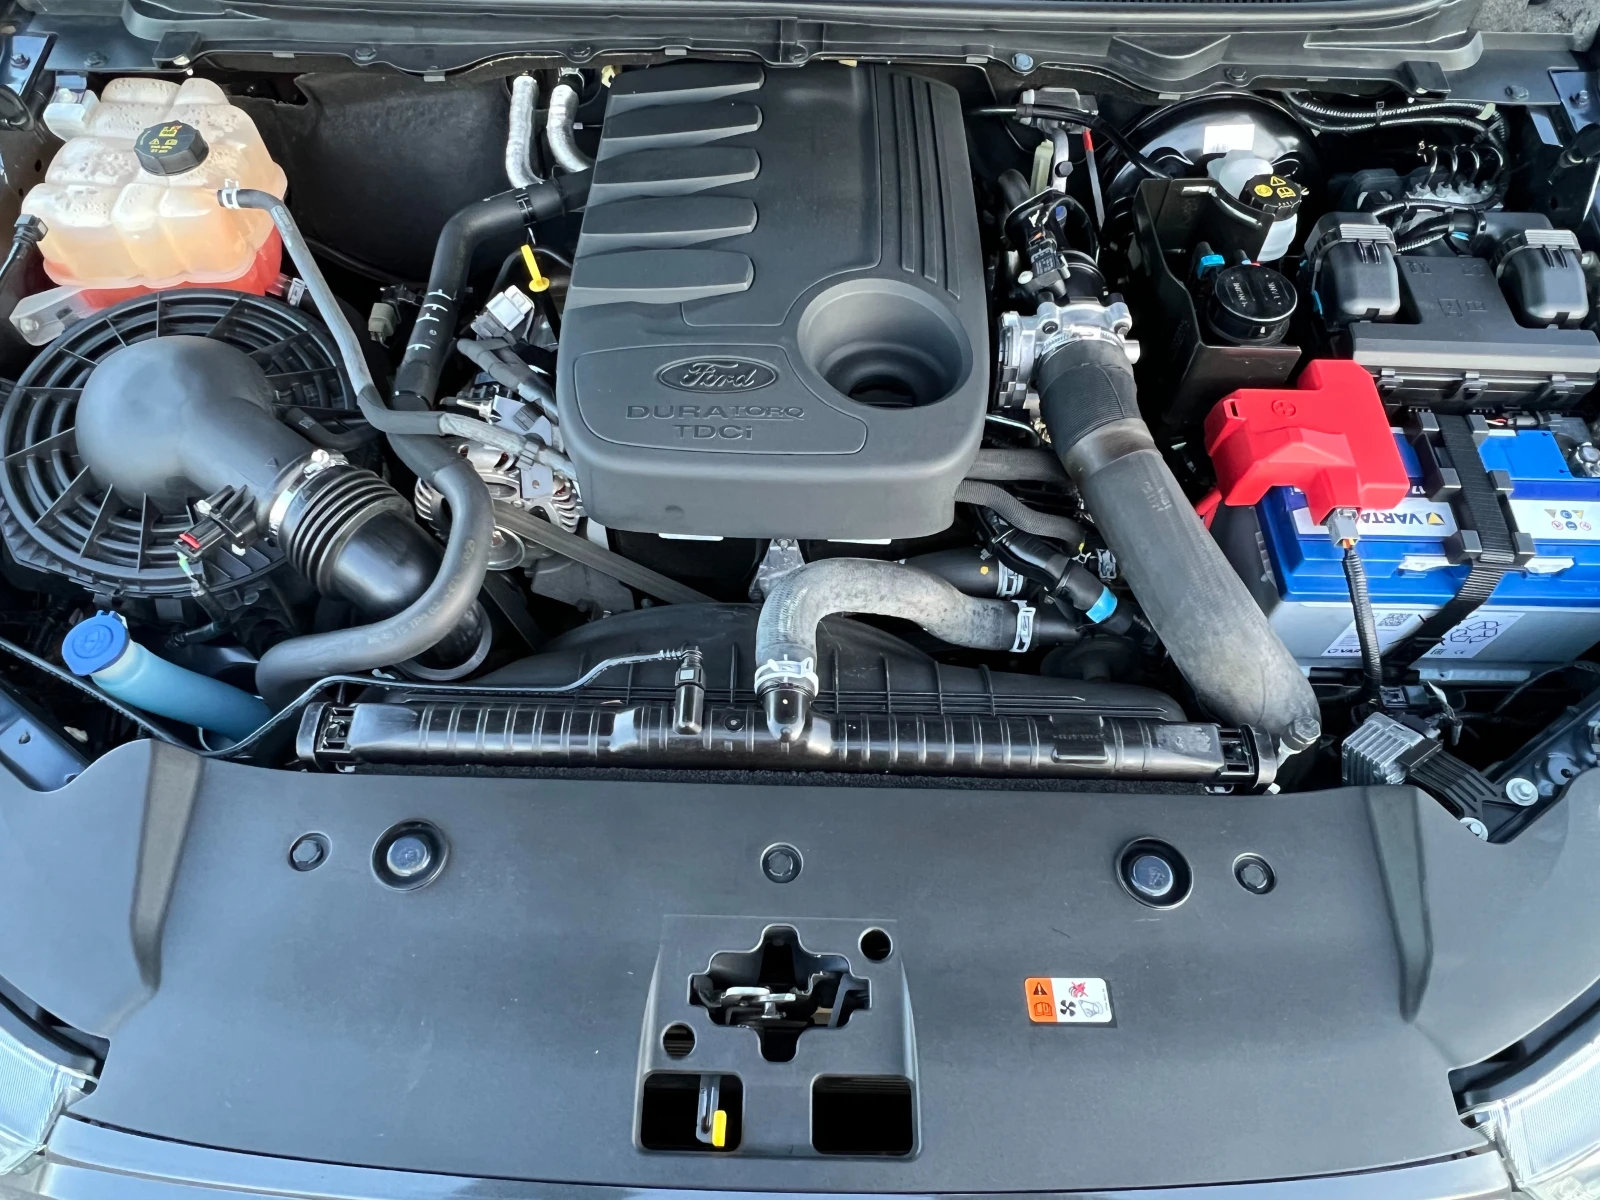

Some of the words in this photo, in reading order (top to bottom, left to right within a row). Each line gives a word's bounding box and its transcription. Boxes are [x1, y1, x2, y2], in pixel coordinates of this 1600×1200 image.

[679, 362, 757, 387] Ford
[672, 424, 753, 440] TDCi
[1361, 511, 1424, 525] VARTA
